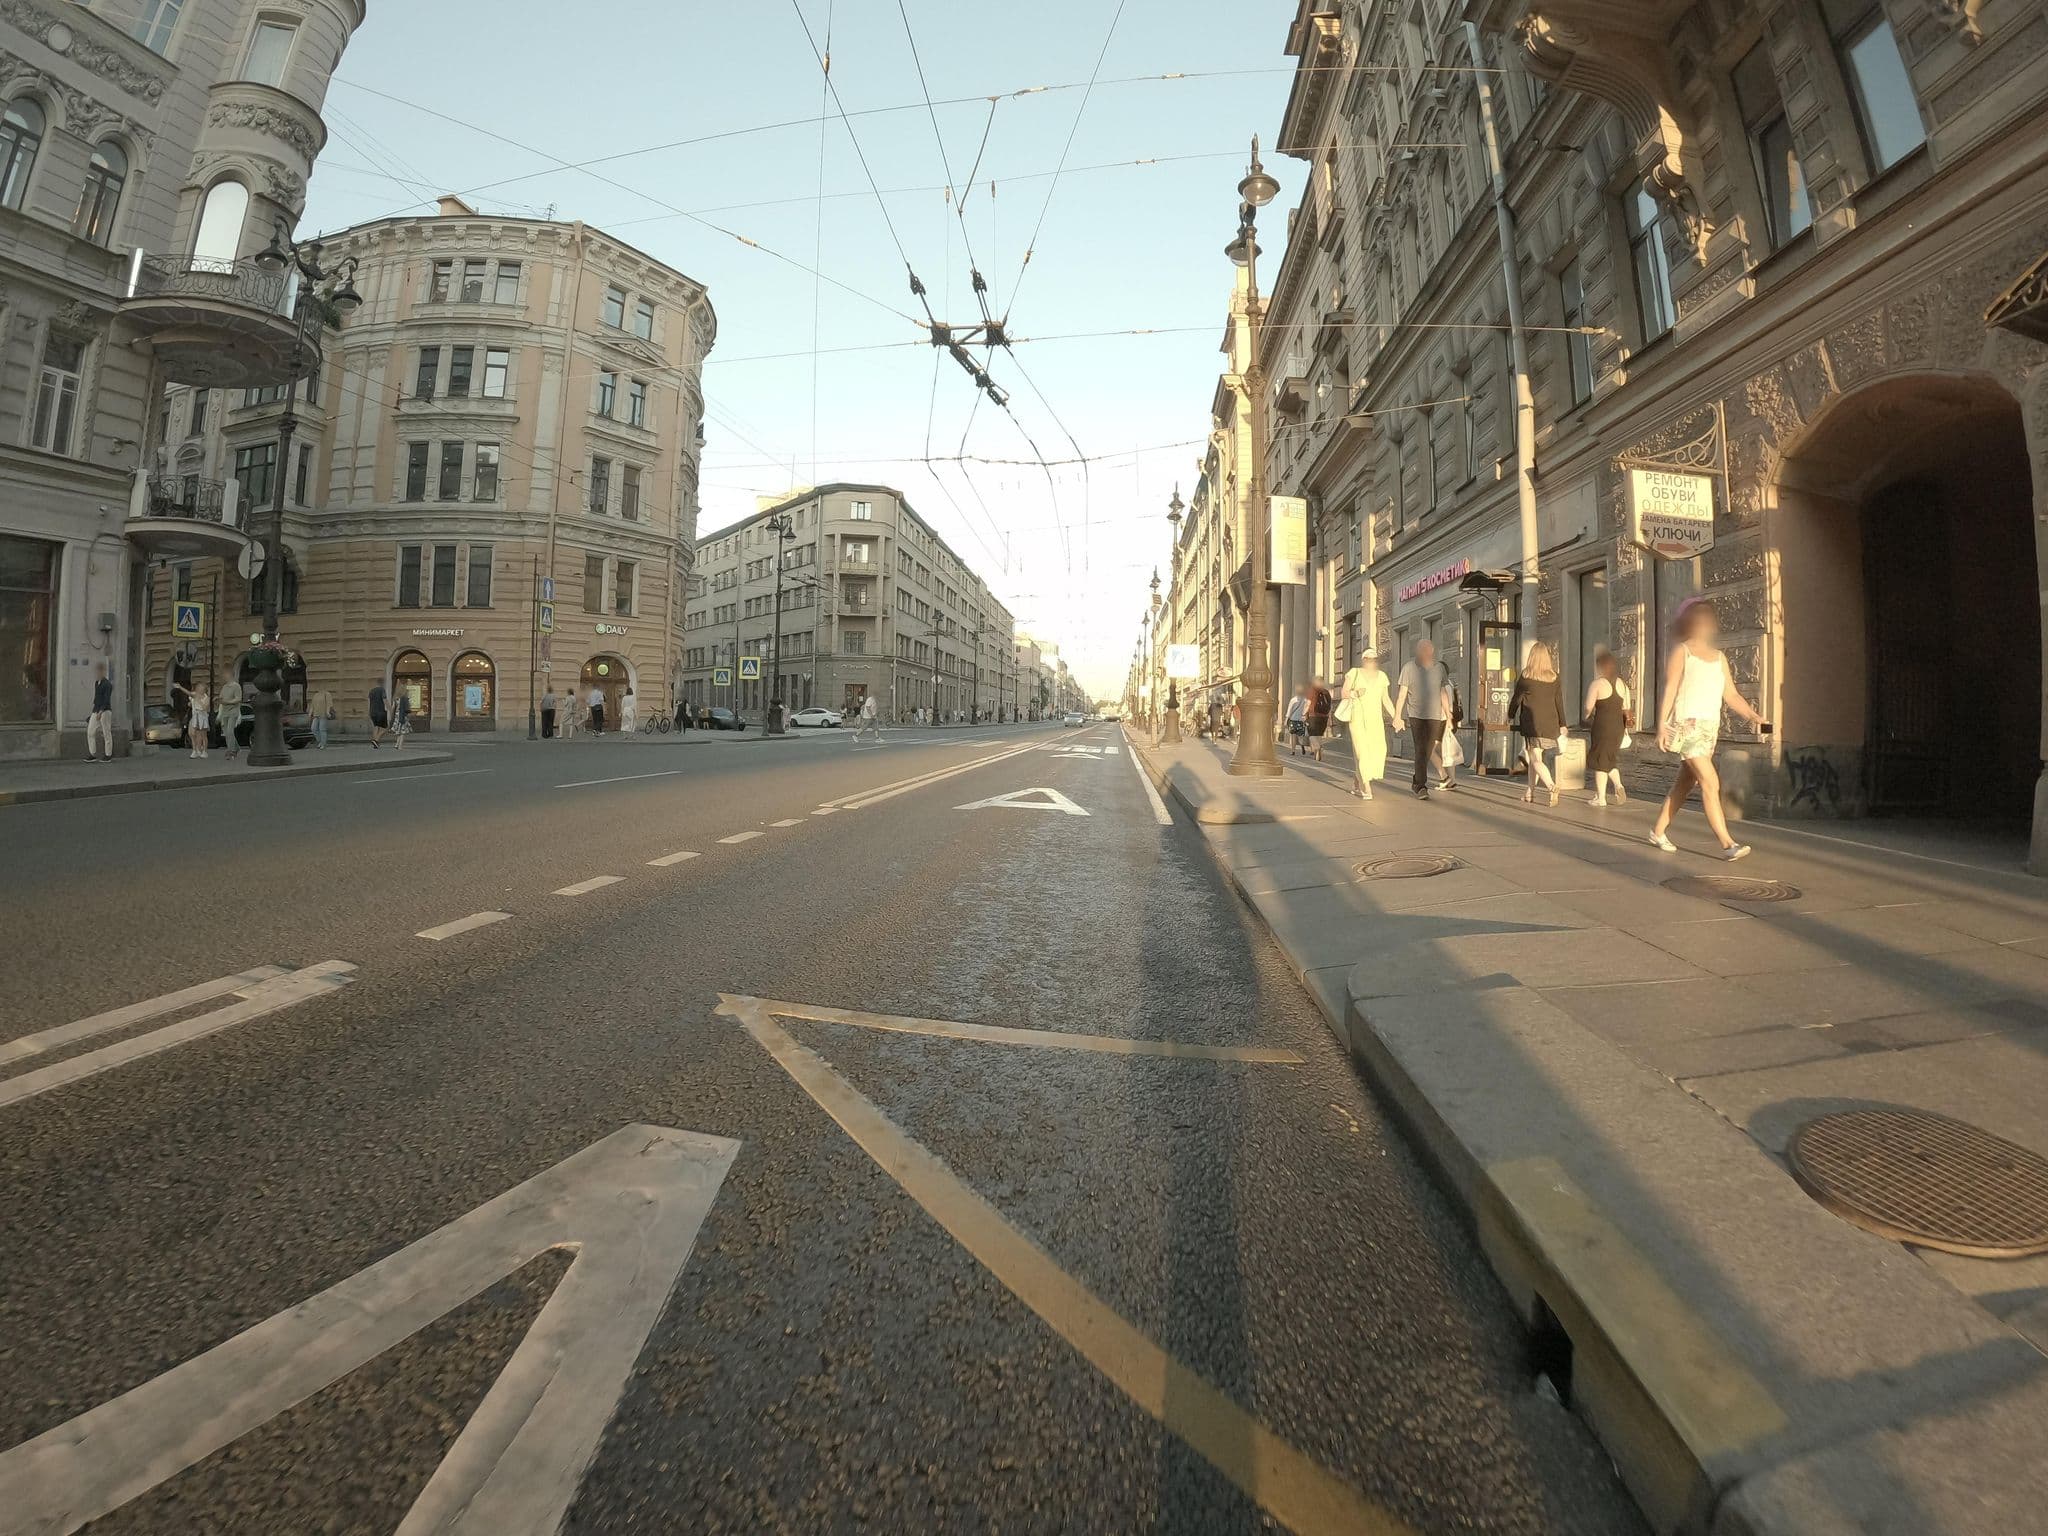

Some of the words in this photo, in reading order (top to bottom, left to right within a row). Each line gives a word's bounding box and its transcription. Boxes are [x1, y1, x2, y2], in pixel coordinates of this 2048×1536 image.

[1645, 472, 1699, 489] РЕМОНТ
[1651, 487, 1696, 503] ОБУВИ
[1641, 499, 1709, 517] ОДЕЖДЫ
[1641, 514, 1671, 525] ЗАМЕНА
[1673, 516, 1712, 528] БАТАРЕЕК
[1653, 526, 1701, 542] КЛЮЧИ
[412, 629, 464, 637] МИНИМАРКЕТ
[606, 624, 628, 635] DAILY
